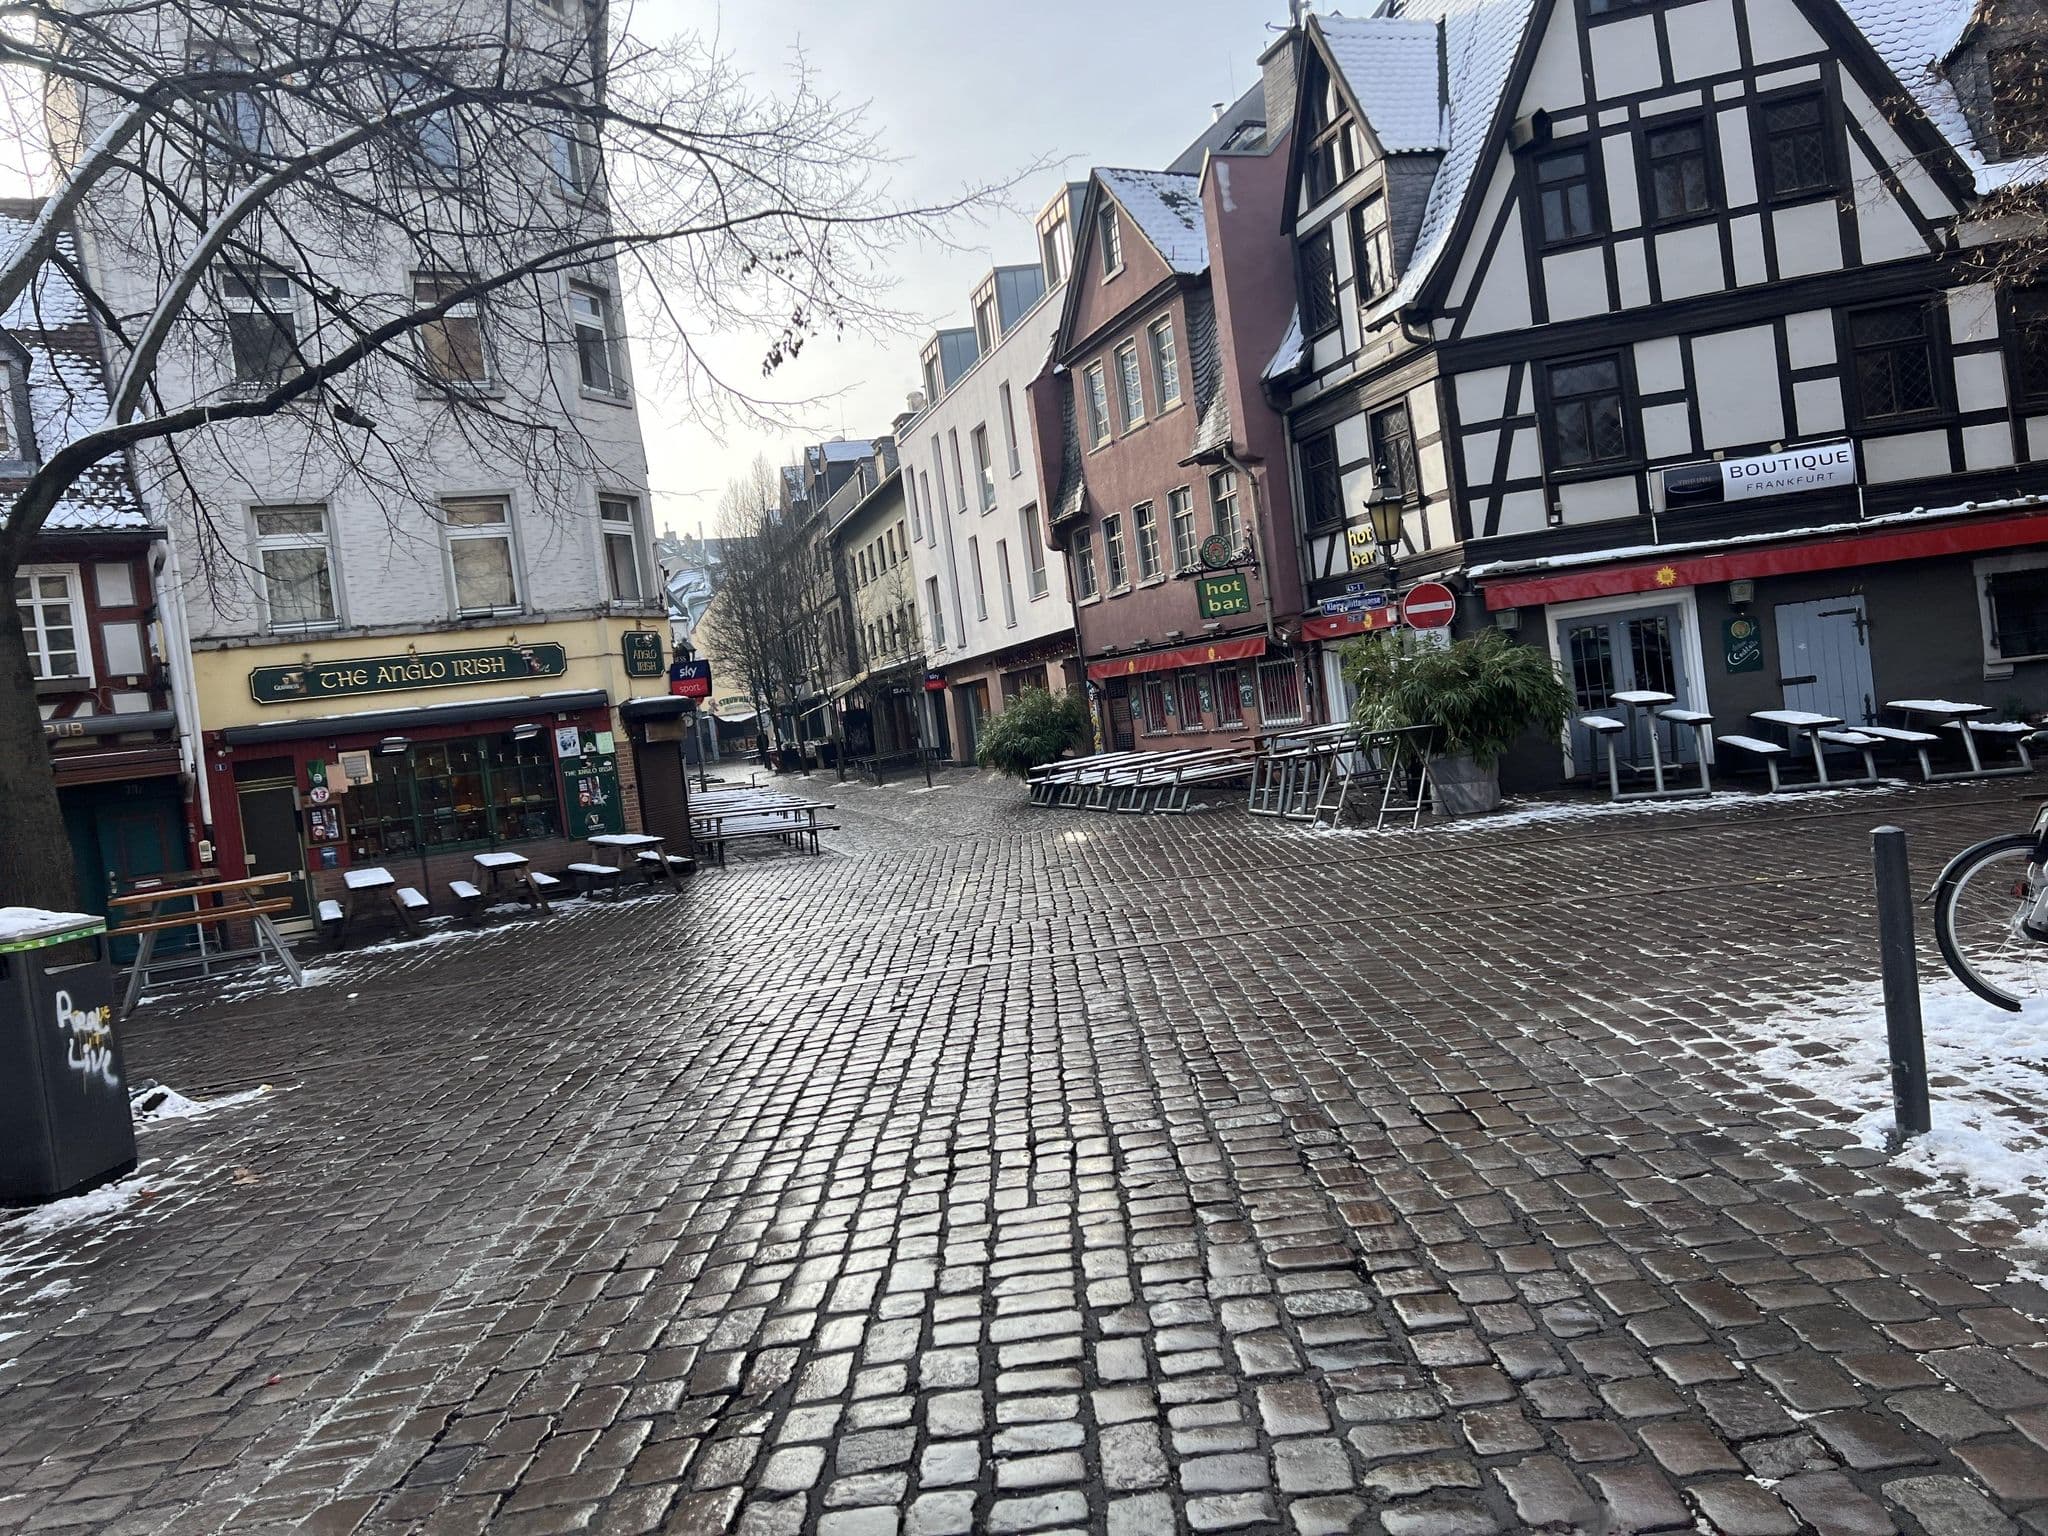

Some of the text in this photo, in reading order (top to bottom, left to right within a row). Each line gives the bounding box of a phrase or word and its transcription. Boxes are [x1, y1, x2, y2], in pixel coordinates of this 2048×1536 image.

[1730, 450, 1849, 479] BOUTIQUE
[1746, 472, 1836, 492] FRANKFURT
[1347, 526, 1373, 547] hot
[1350, 550, 1376, 567] bar
[1206, 580, 1241, 596] hot
[1209, 598, 1243, 612] bar
[633, 649, 657, 660] ANGLO
[320, 656, 506, 689] THE ANGLO IRISH
[636, 661, 657, 672] IRISH
[680, 665, 697, 678] sky
[680, 683, 701, 693] sport
[313, 790, 327, 800] 13
